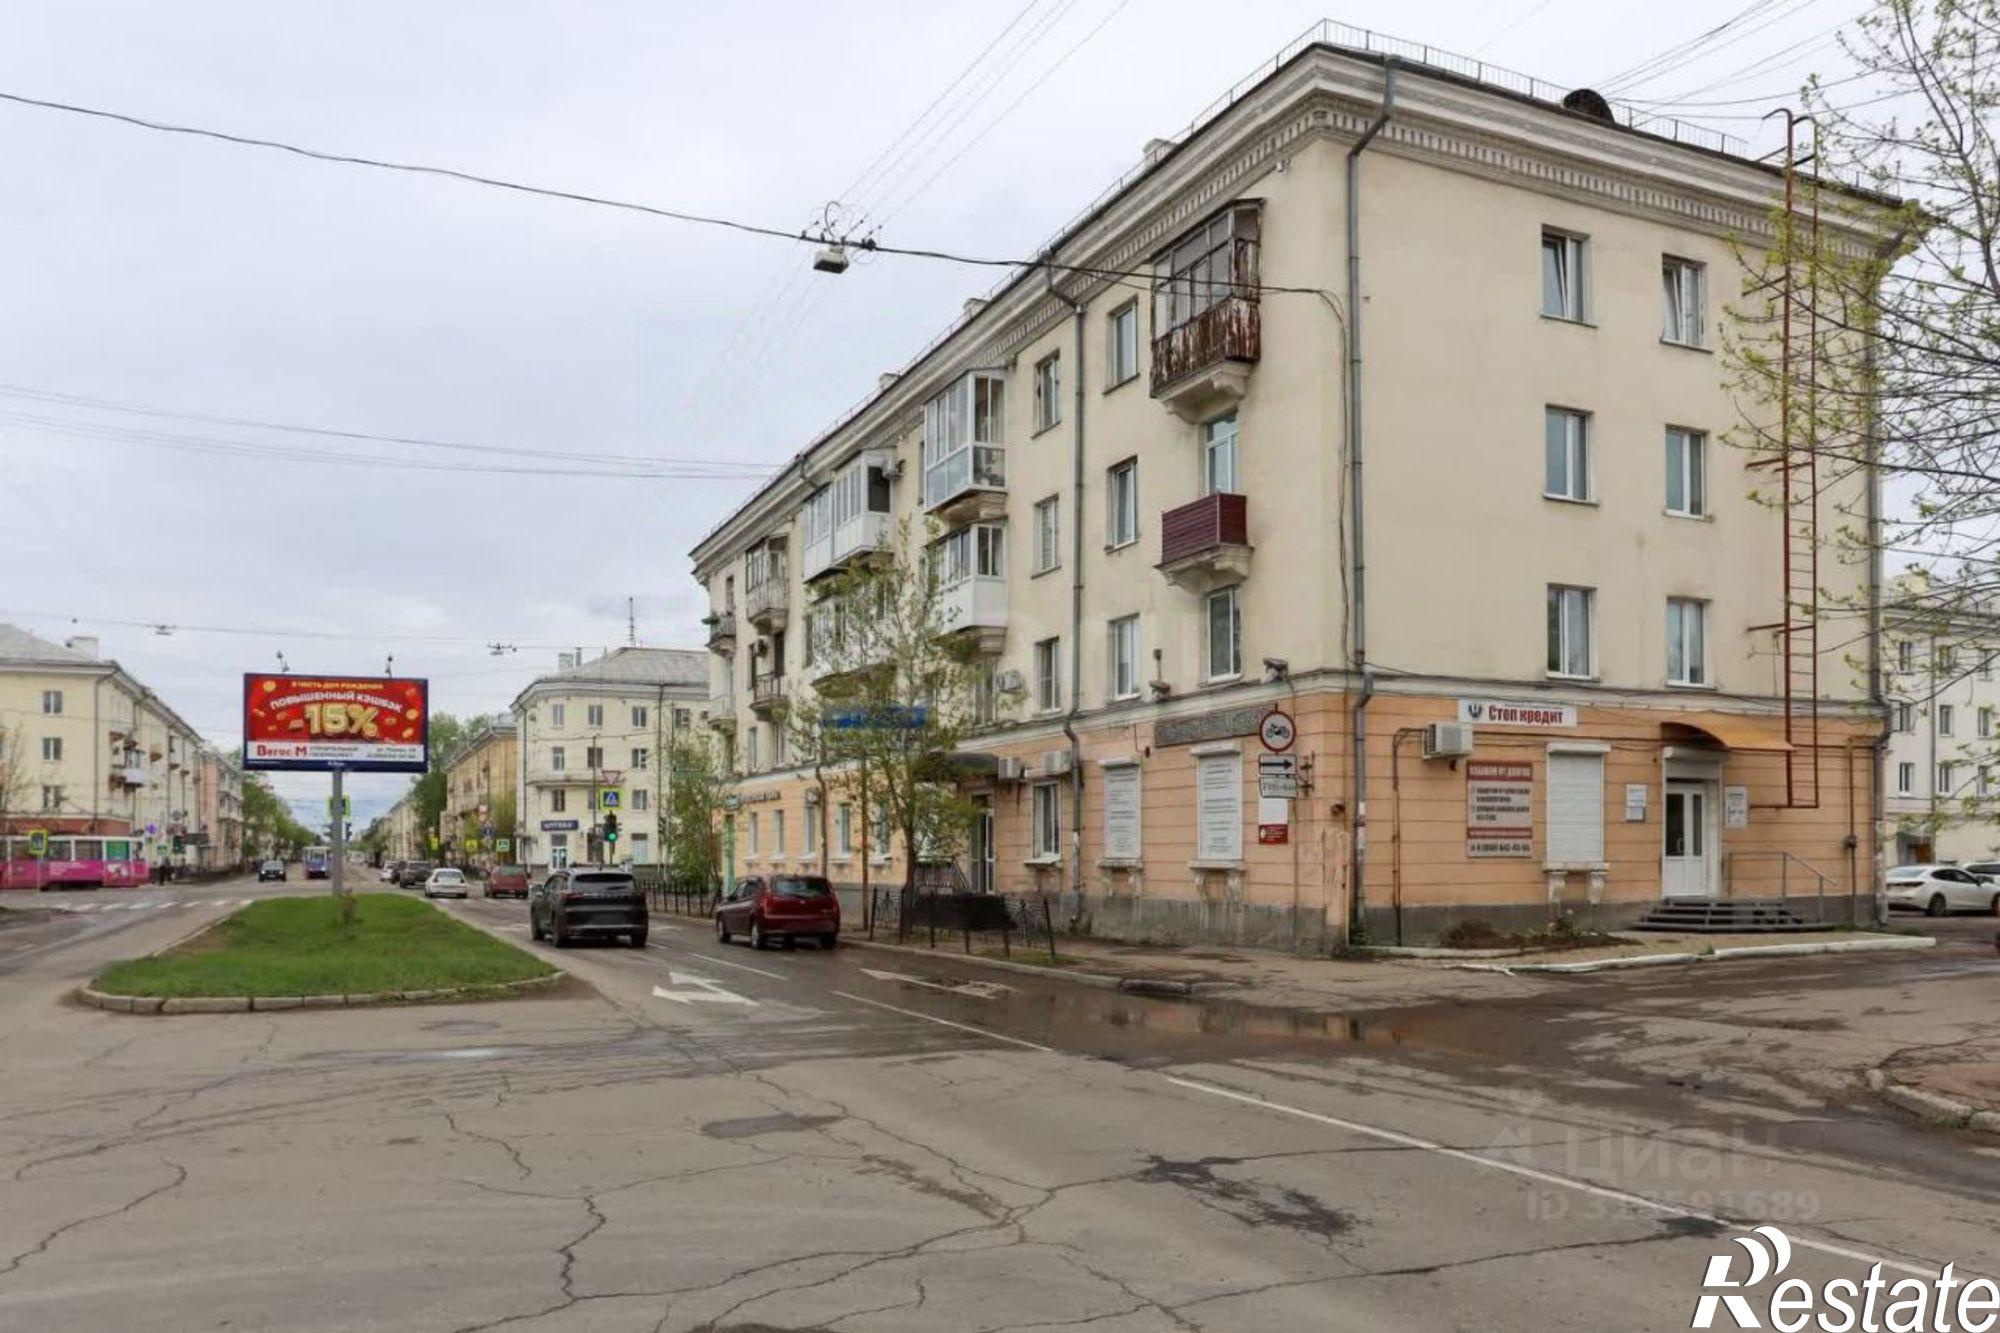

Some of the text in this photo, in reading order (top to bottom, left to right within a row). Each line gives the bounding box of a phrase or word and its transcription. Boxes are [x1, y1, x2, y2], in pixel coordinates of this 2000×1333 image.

[305, 702, 379, 737] 15%
[1488, 705, 1518, 721] Стоп
[1519, 709, 1564, 724] кредит
